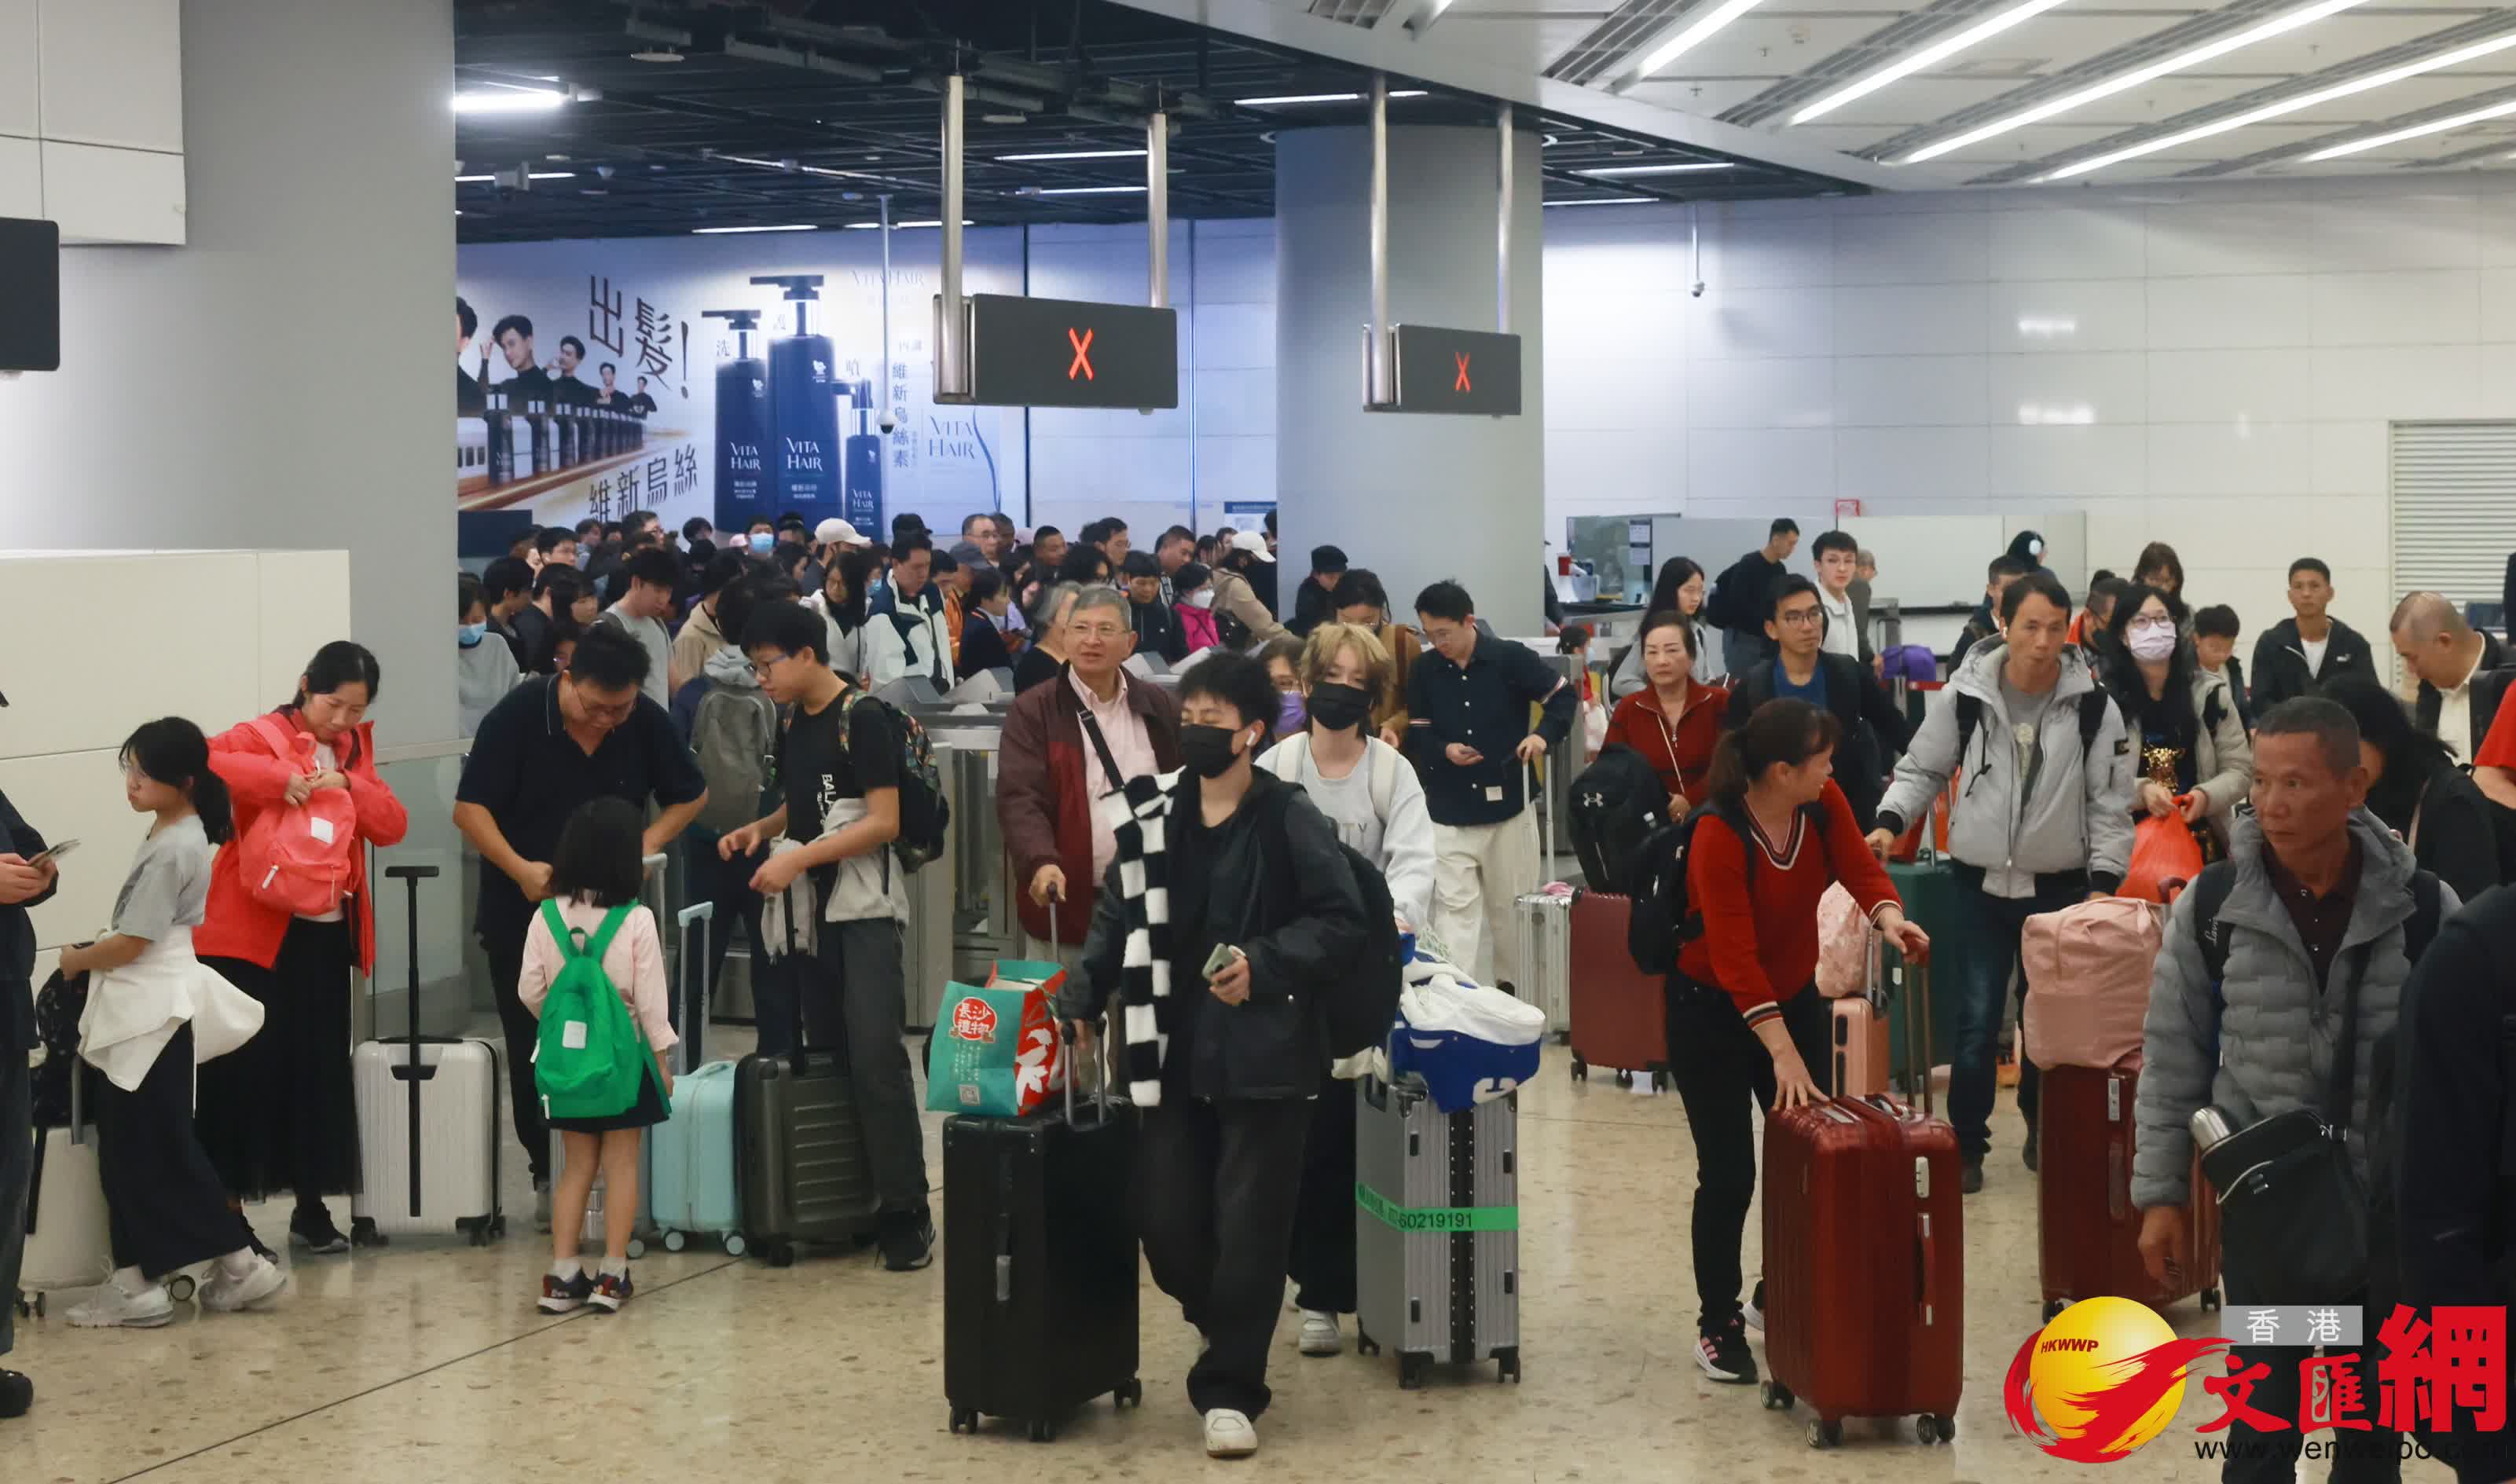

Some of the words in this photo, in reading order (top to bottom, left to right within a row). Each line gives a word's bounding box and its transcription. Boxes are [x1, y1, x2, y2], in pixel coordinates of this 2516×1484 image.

[930, 416, 974, 435] VITA
[730, 442, 758, 456] VITA
[787, 437, 820, 453] VITA
[930, 438, 975, 460] HAIR
[731, 456, 761, 471] HAIR
[787, 455, 823, 471] HAIR
[852, 488, 873, 499] VITA
[853, 499, 874, 509] HAIR
[958, 1002, 992, 1020] 長沙
